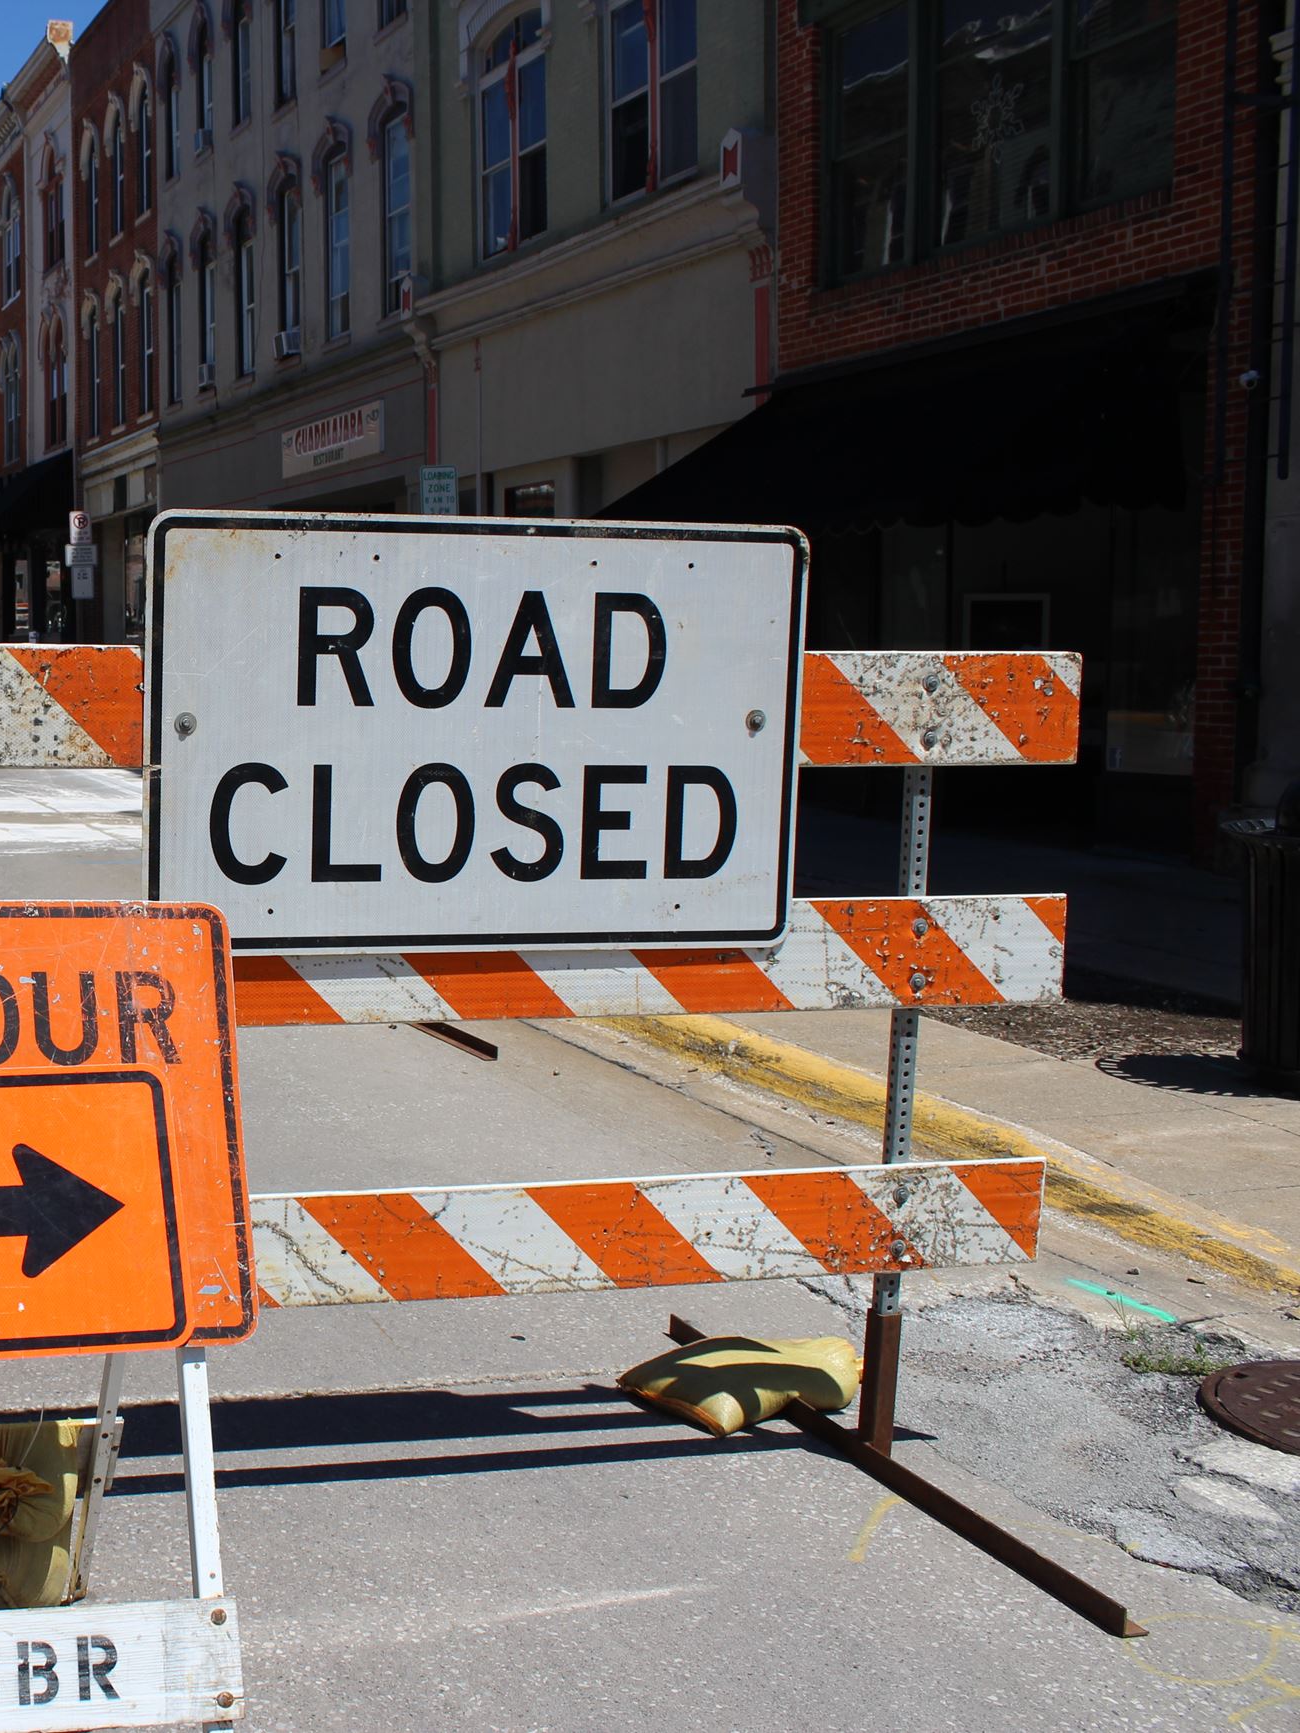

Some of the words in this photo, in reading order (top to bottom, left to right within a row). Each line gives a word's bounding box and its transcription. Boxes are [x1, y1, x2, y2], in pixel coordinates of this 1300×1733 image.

[295, 408, 364, 455] GUADALAJARA
[313, 447, 345, 466] RESTAURANT
[424, 471, 454, 480] LOADING
[428, 483, 451, 493] ZONE
[433, 496, 443, 504] AM
[446, 496, 455, 504] TO
[296, 585, 667, 709] ROAD
[209, 762, 738, 885] CLOSED
